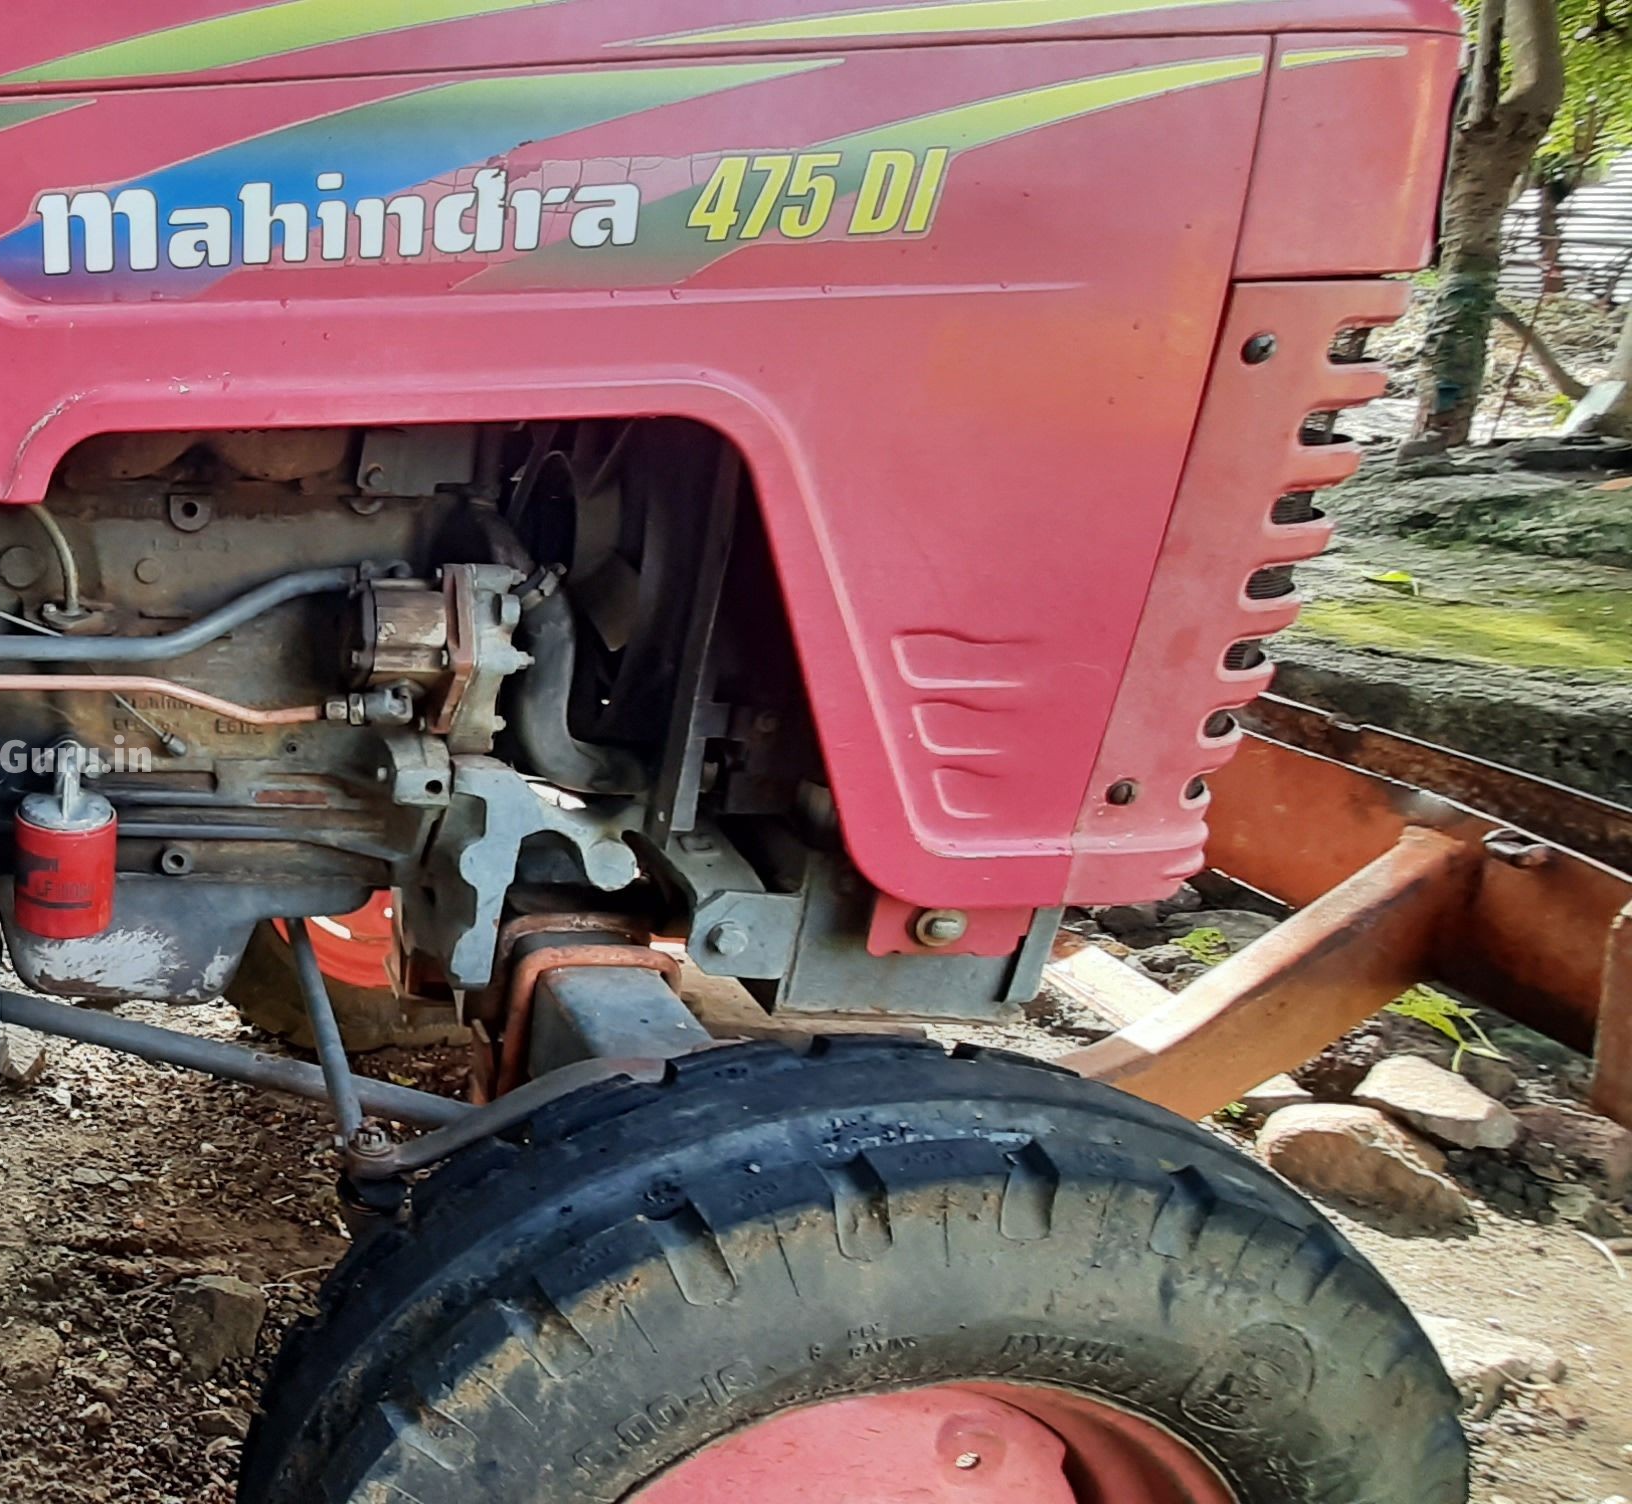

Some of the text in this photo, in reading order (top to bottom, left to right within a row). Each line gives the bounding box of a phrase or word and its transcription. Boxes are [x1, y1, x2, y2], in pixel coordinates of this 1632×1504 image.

[36, 148, 950, 276] Mahindra 475 DI
